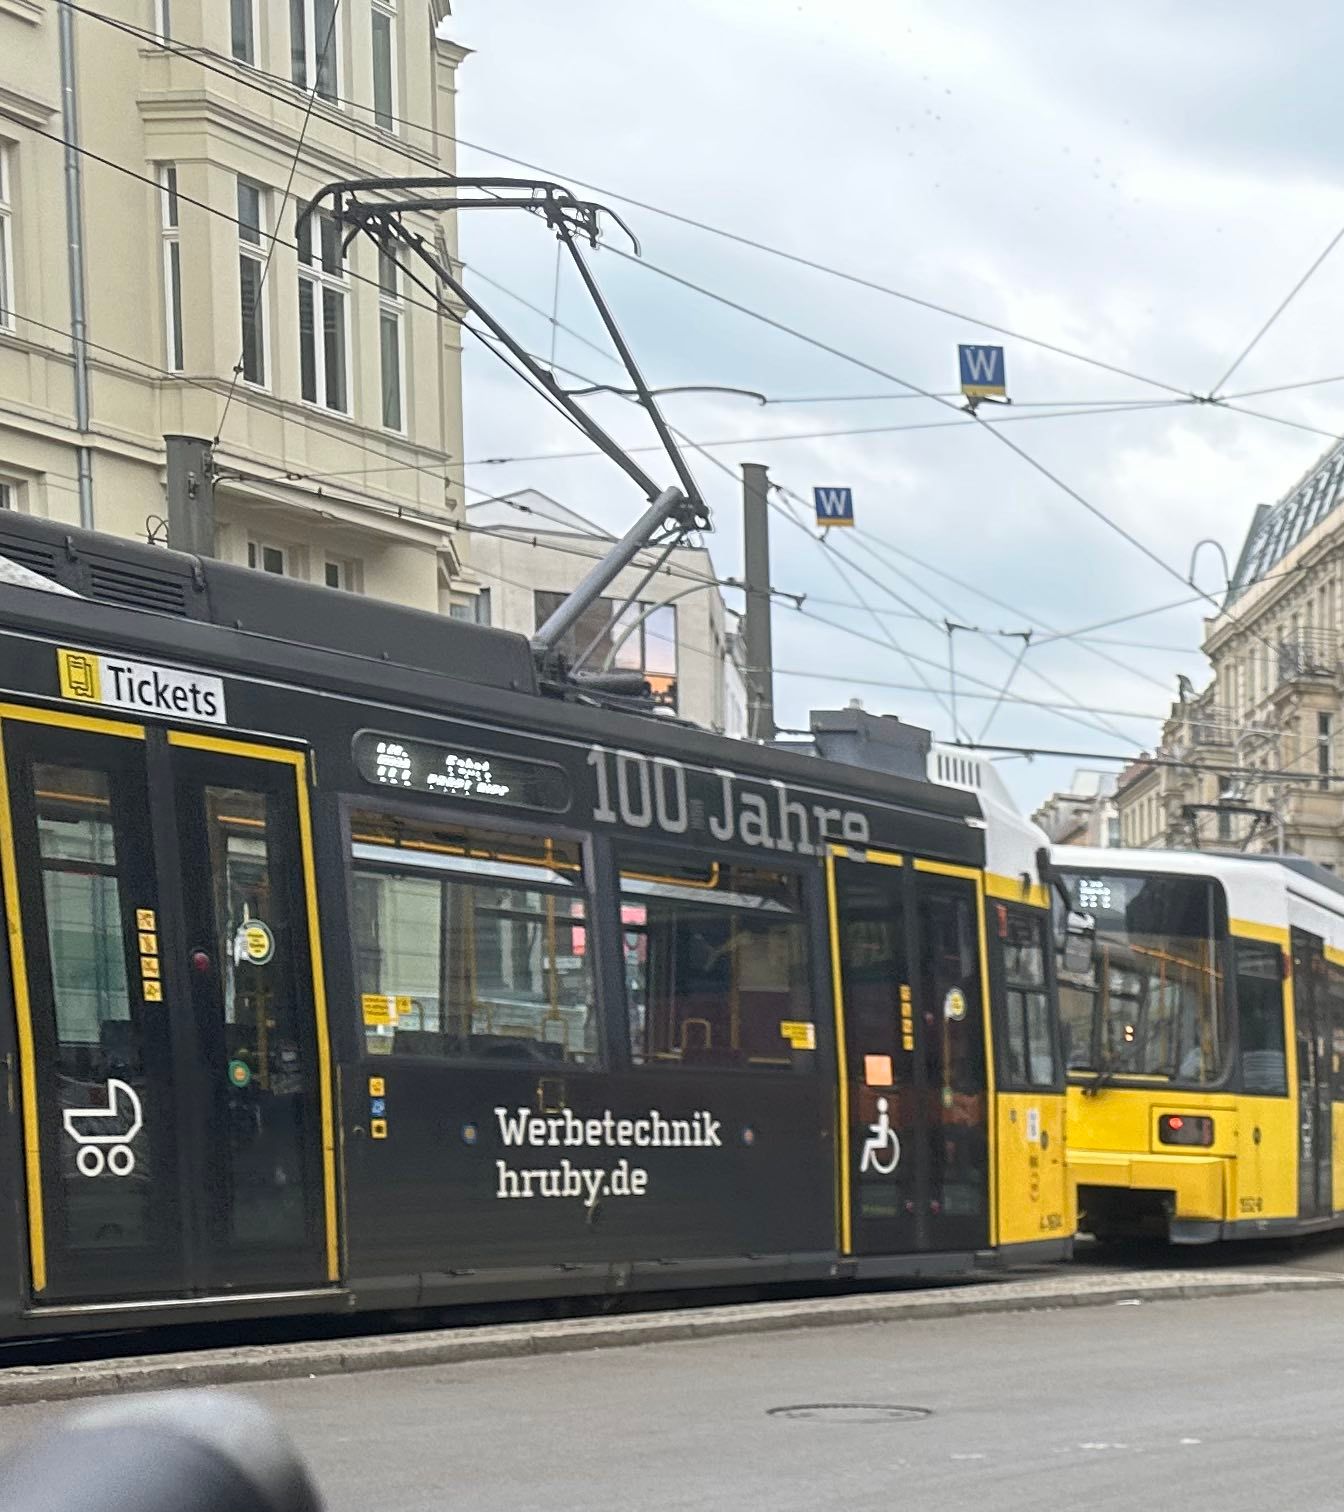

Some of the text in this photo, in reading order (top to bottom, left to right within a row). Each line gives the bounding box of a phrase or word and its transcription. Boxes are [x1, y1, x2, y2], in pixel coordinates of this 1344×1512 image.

[965, 348, 1000, 383] W
[818, 488, 847, 517] W
[107, 664, 218, 716] Tickets
[587, 744, 689, 834] 100
[708, 767, 871, 863] Jahre
[494, 1107, 723, 1147] Werbetechnik
[495, 1159, 649, 1208] hruby.de
